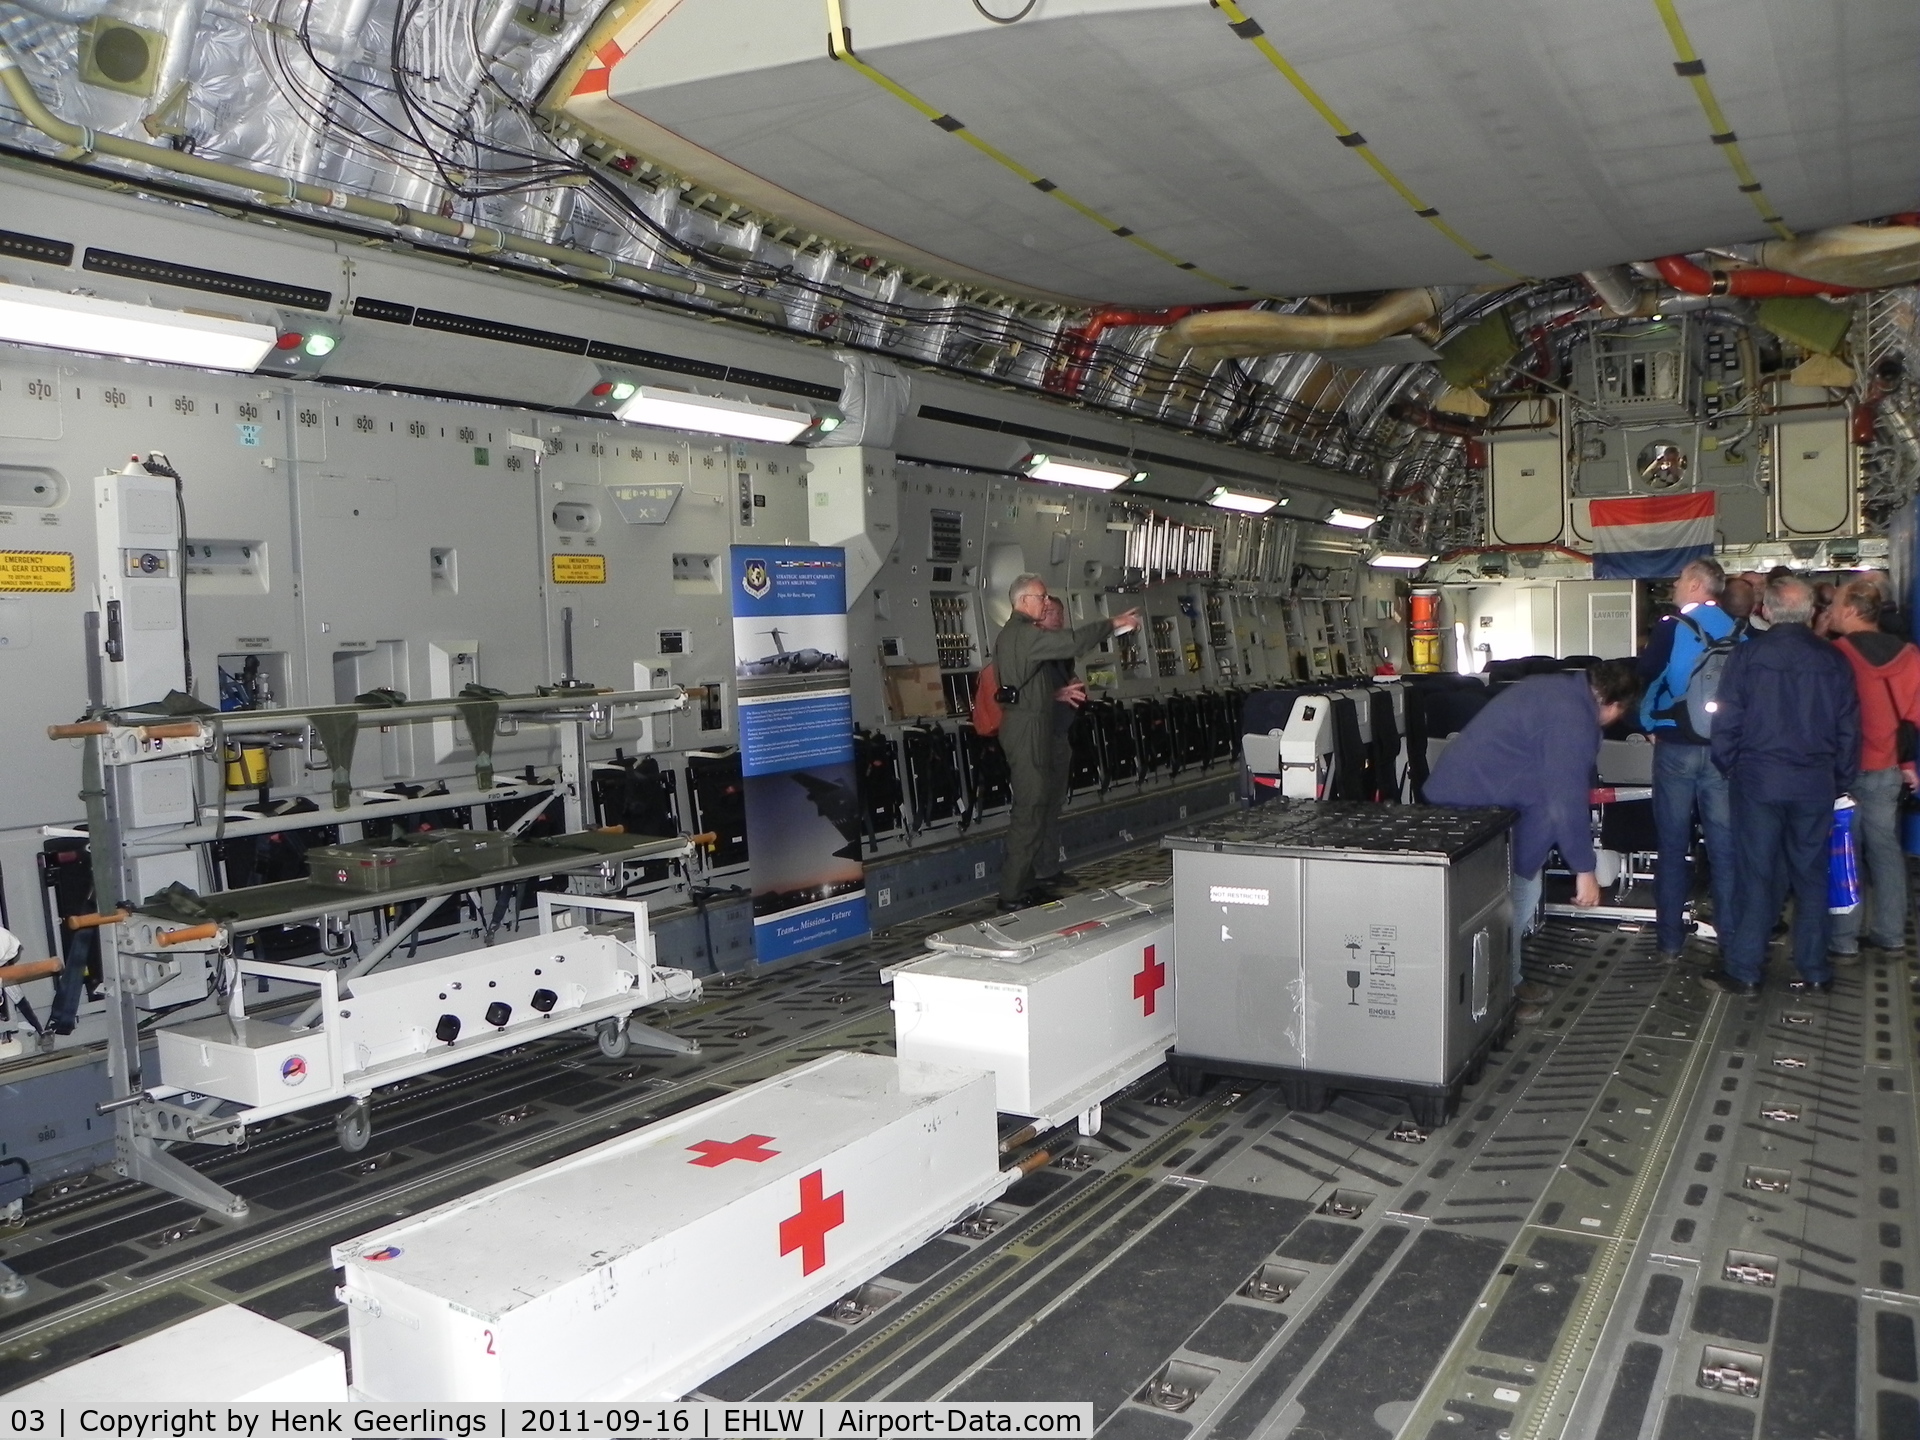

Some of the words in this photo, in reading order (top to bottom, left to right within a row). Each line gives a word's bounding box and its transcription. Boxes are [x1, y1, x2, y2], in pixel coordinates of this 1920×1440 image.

[28, 382, 51, 397] 970
[105, 391, 126, 405] 960
[175, 398, 195, 413] 950
[239, 405, 258, 419] 940
[300, 412, 317, 425] 930
[357, 418, 373, 431] 920
[410, 424, 425, 437] 910
[459, 429, 474, 441] 900
[507, 458, 521, 470] 890
[5, 556, 43, 564] EMERGENCY
[31, 565, 66, 573] EXTENSION
[1593, 611, 1630, 619] LAVATORY
[1227, 892, 1267, 900] RESTRICTED
[831, 910, 852, 921] Future
[1015, 997, 1023, 1013] 3
[38, 1129, 56, 1142] 980
[484, 1329, 496, 1356] 2
